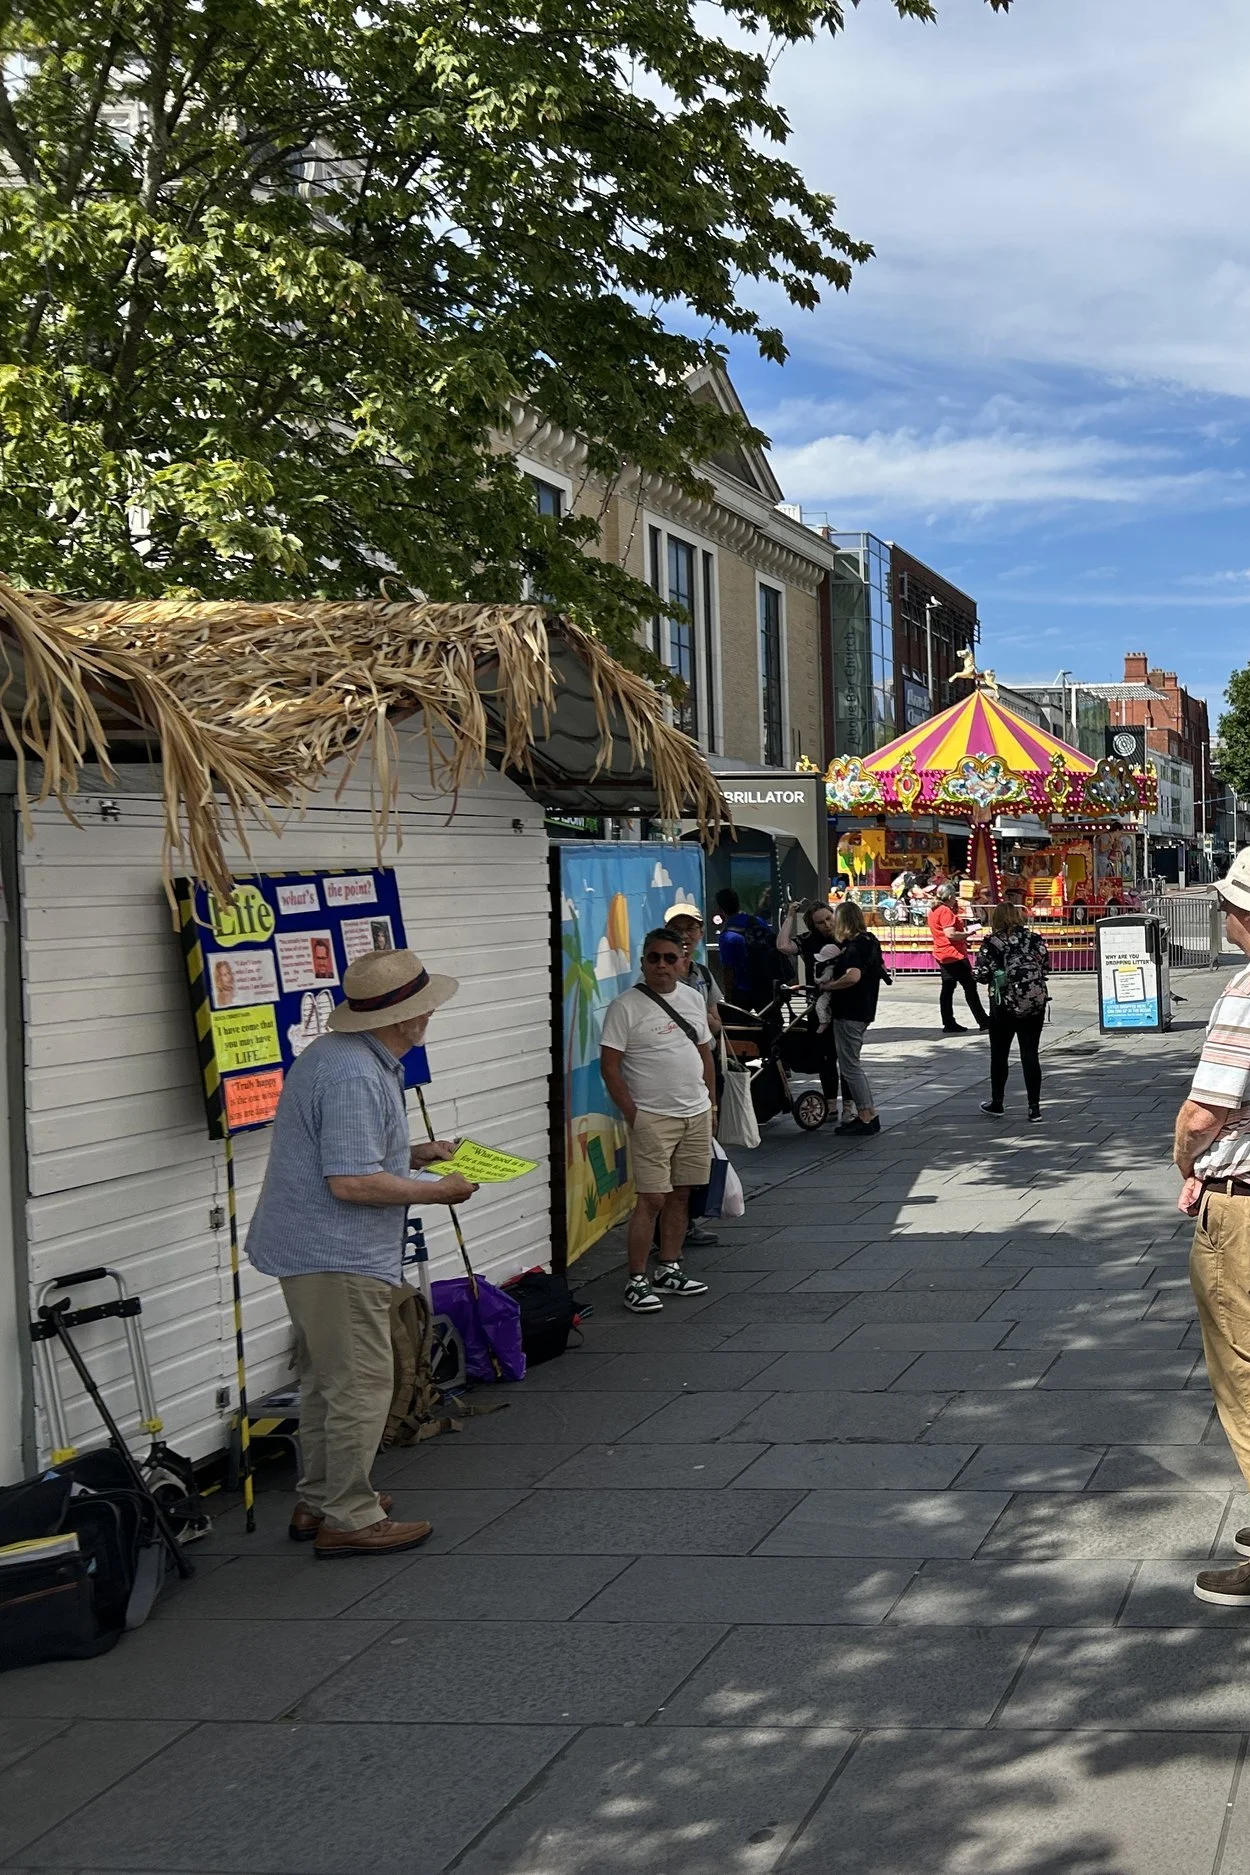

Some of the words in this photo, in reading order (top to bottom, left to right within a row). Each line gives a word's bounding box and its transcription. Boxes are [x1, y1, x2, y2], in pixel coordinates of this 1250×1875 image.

[720, 791, 805, 804] BRILLATOR
[212, 892, 273, 938] Life
[282, 890, 315, 907] what's
[328, 883, 343, 898] the
[344, 880, 372, 900] point?
